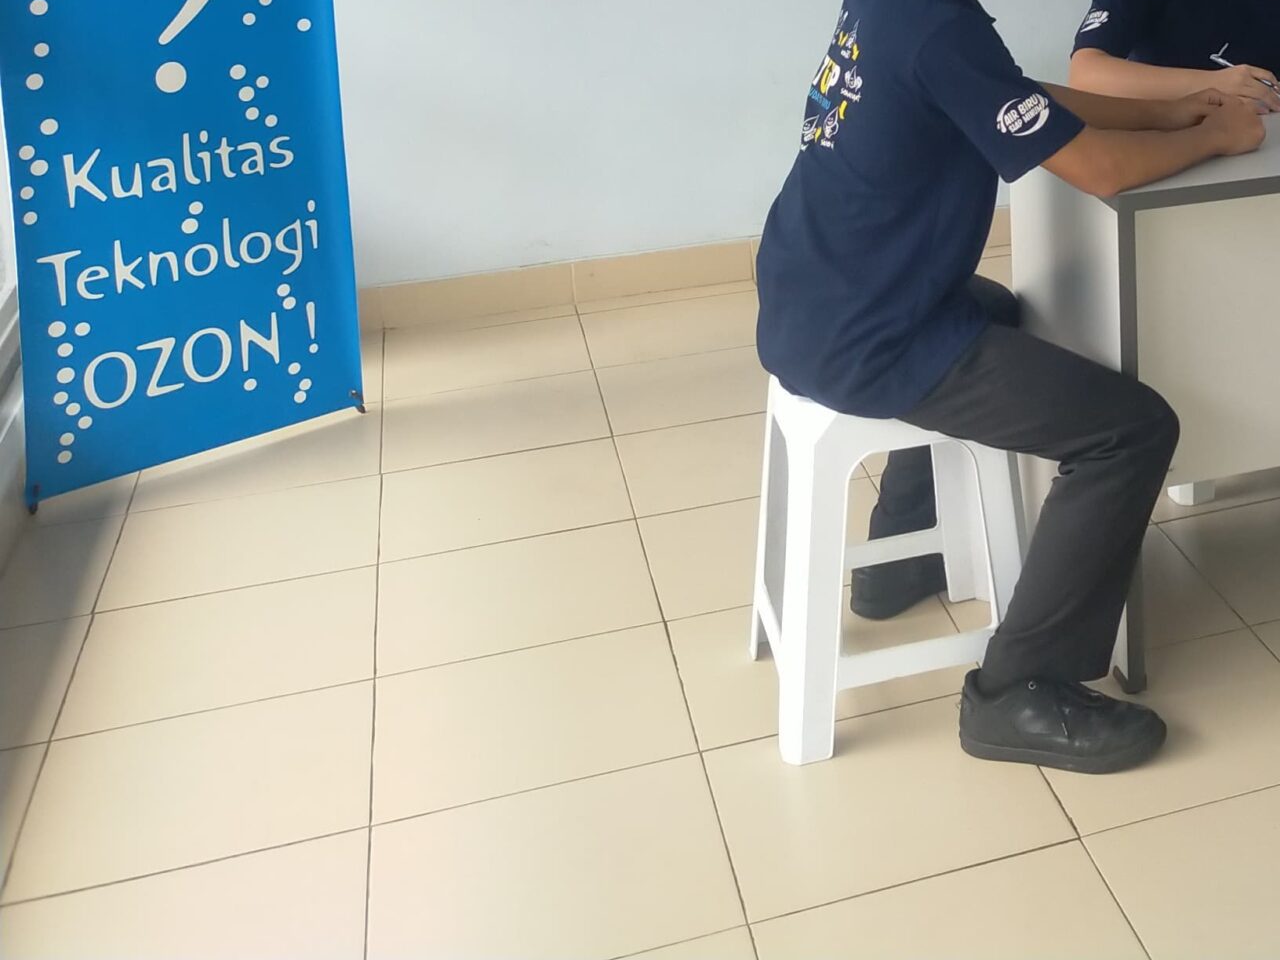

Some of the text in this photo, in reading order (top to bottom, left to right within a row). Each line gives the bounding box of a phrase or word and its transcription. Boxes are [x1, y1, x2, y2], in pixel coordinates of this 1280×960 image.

[1004, 93, 1039, 126] AIR BIRU
[62, 130, 295, 209] Kualitas
[36, 199, 319, 306] Teknologi
